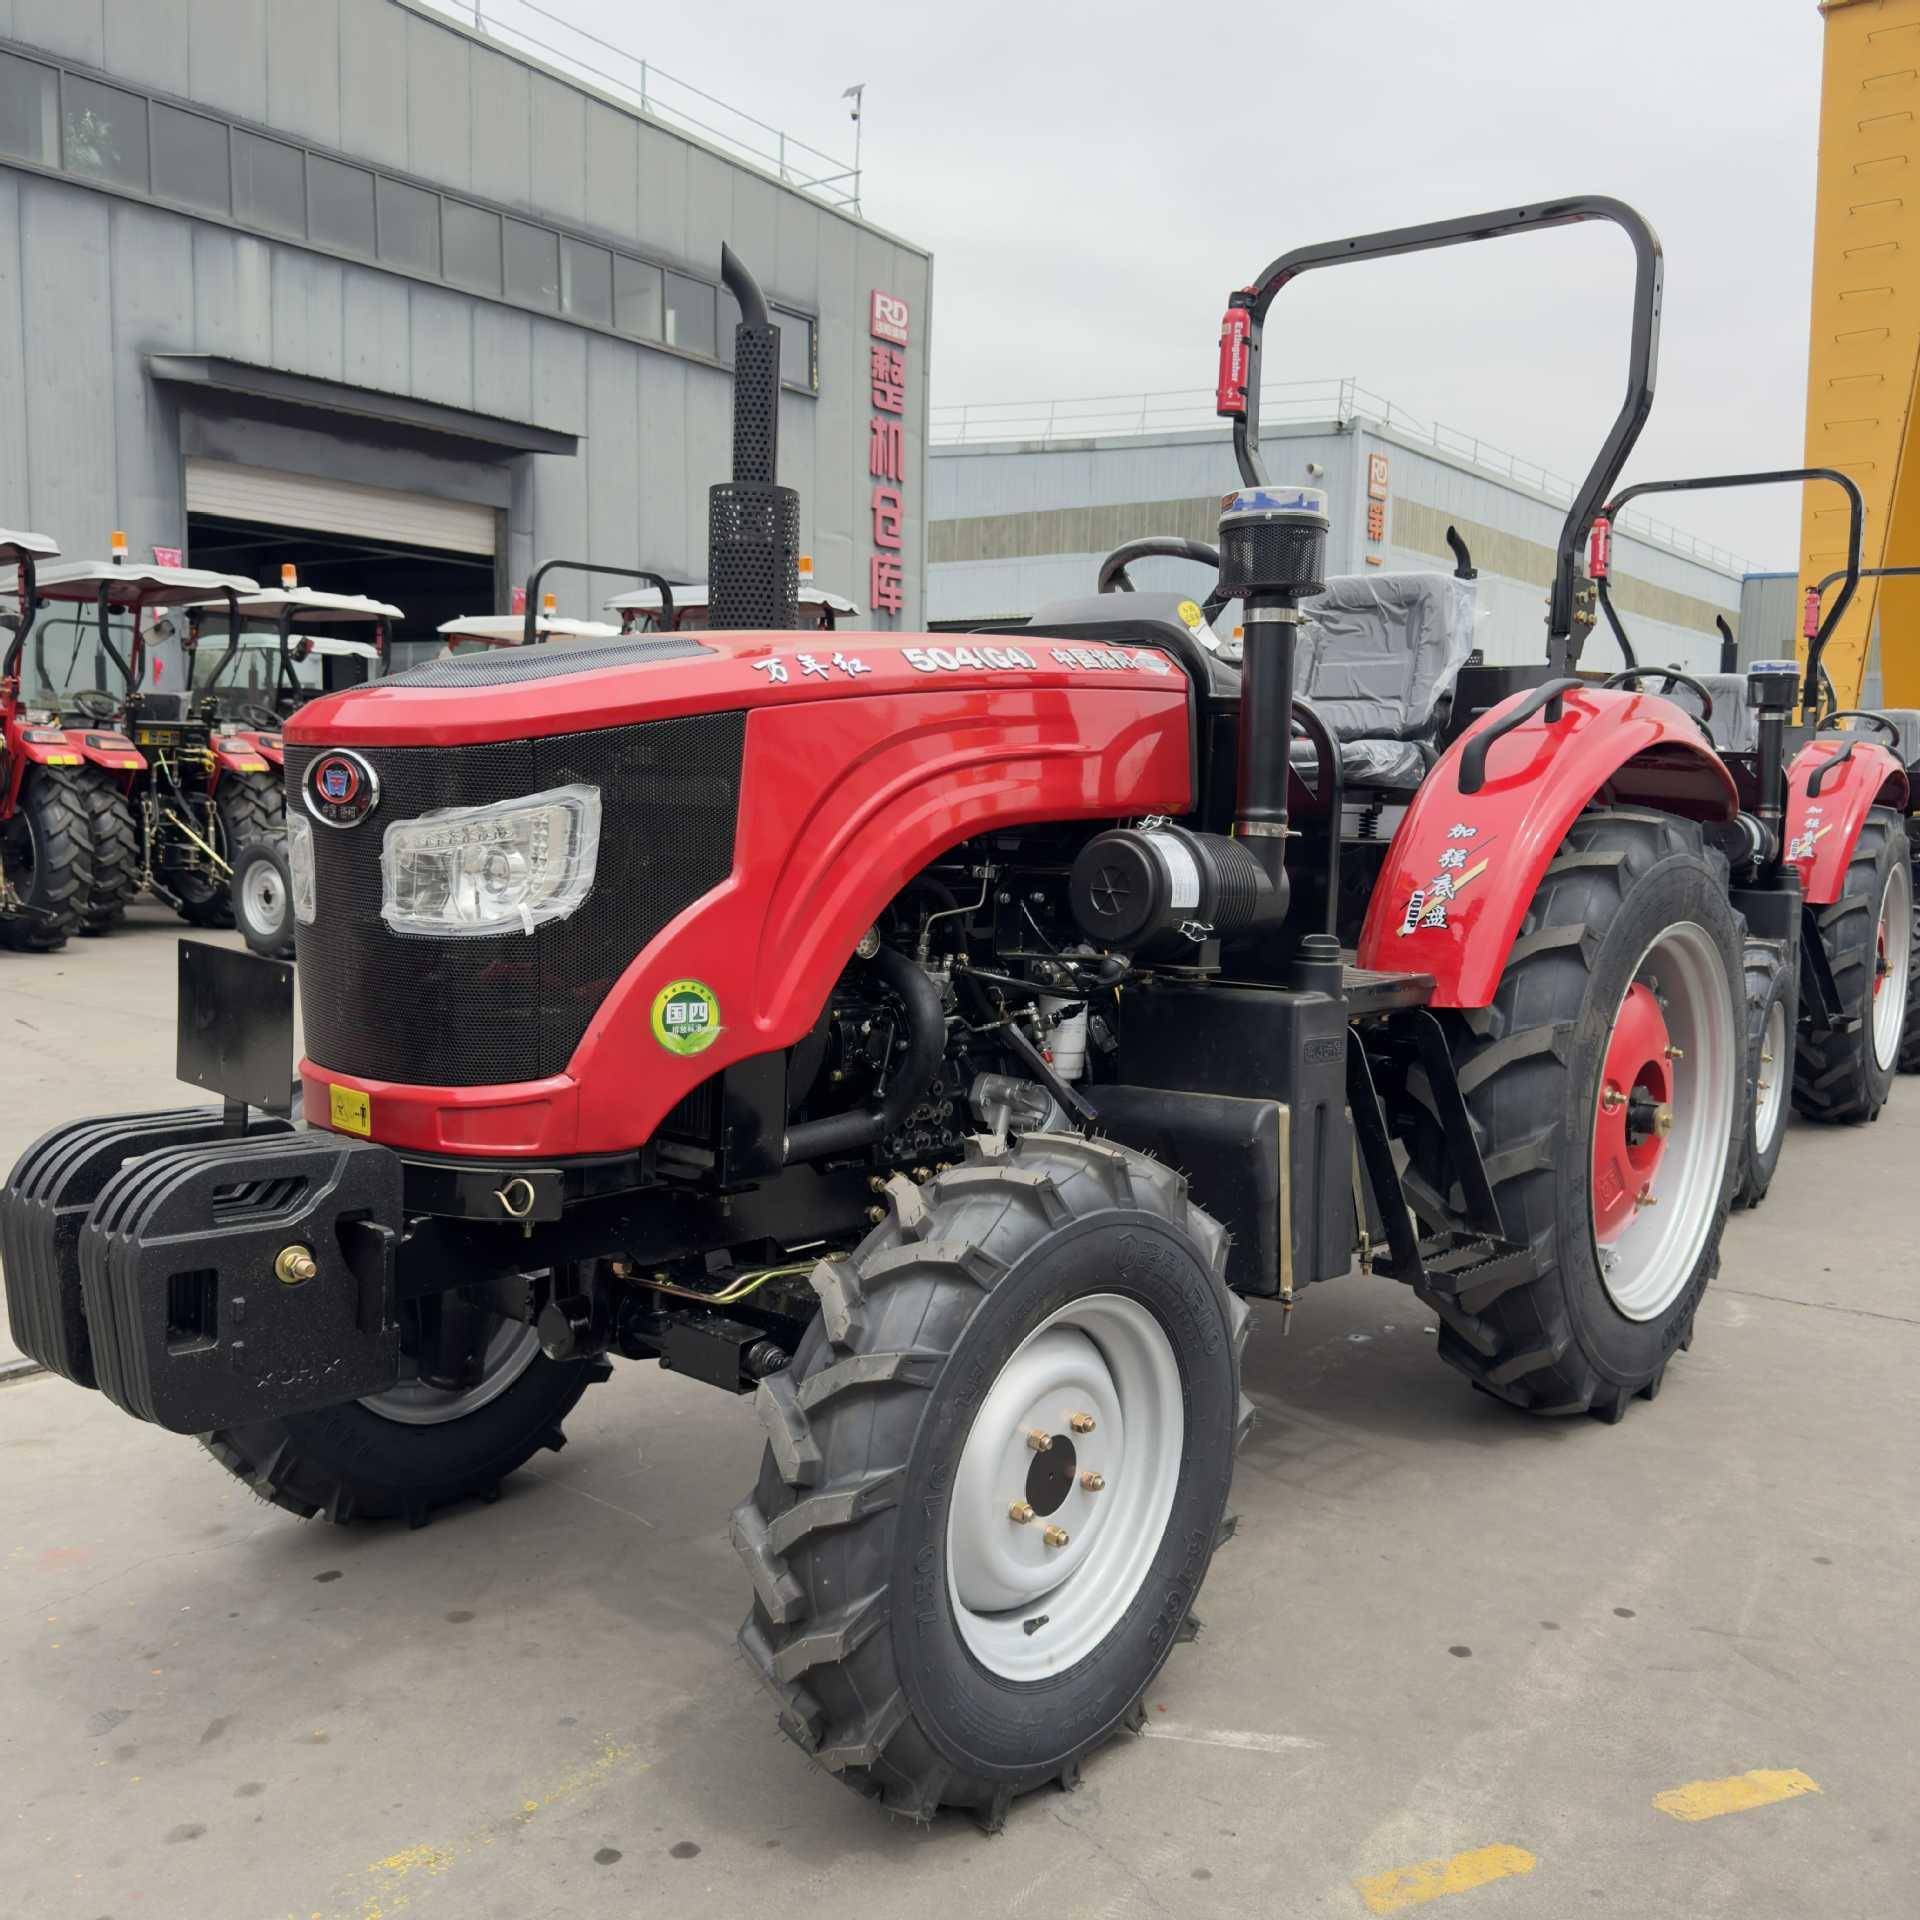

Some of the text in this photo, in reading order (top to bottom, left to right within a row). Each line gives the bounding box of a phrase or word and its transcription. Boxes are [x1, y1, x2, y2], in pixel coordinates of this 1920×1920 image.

[875, 293, 908, 328] RD
[1231, 321, 1243, 382] Extinguisher
[870, 345, 904, 615] 整机仓库
[751, 652, 872, 683] 万年红
[901, 647, 1037, 672] 504(G4)
[667, 1003, 708, 1024] 国四
